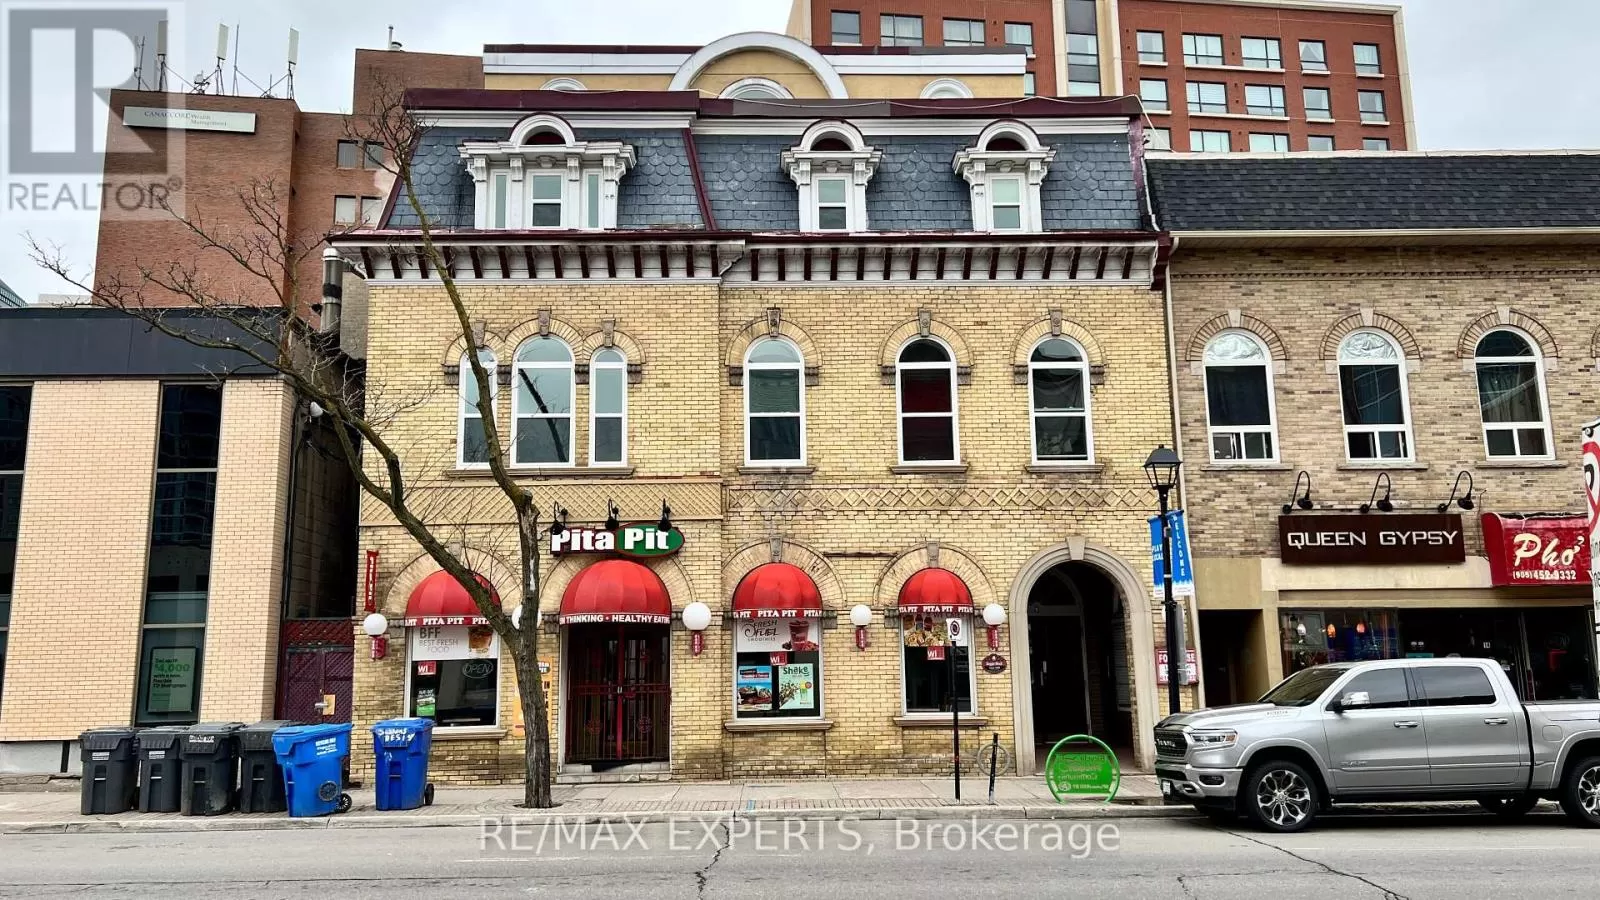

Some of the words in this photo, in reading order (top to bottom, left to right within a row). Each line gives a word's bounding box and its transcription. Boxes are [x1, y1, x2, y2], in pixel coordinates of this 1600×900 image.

[551, 528, 615, 552] Pita
[624, 527, 669, 550] Pit
[1287, 532, 1367, 549] QUEEN
[1379, 531, 1458, 545] GYPSY
[757, 610, 779, 618] PITA
[922, 605, 940, 613] PITA
[422, 618, 446, 626] PITA
[447, 617, 464, 625] PIT
[566, 614, 604, 623] THINKING
[611, 614, 653, 623] HEALTHY
[419, 626, 441, 639] BFF
[418, 638, 436, 647] BEST
[436, 637, 459, 647] FRESH
[783, 666, 809, 676] Shake
